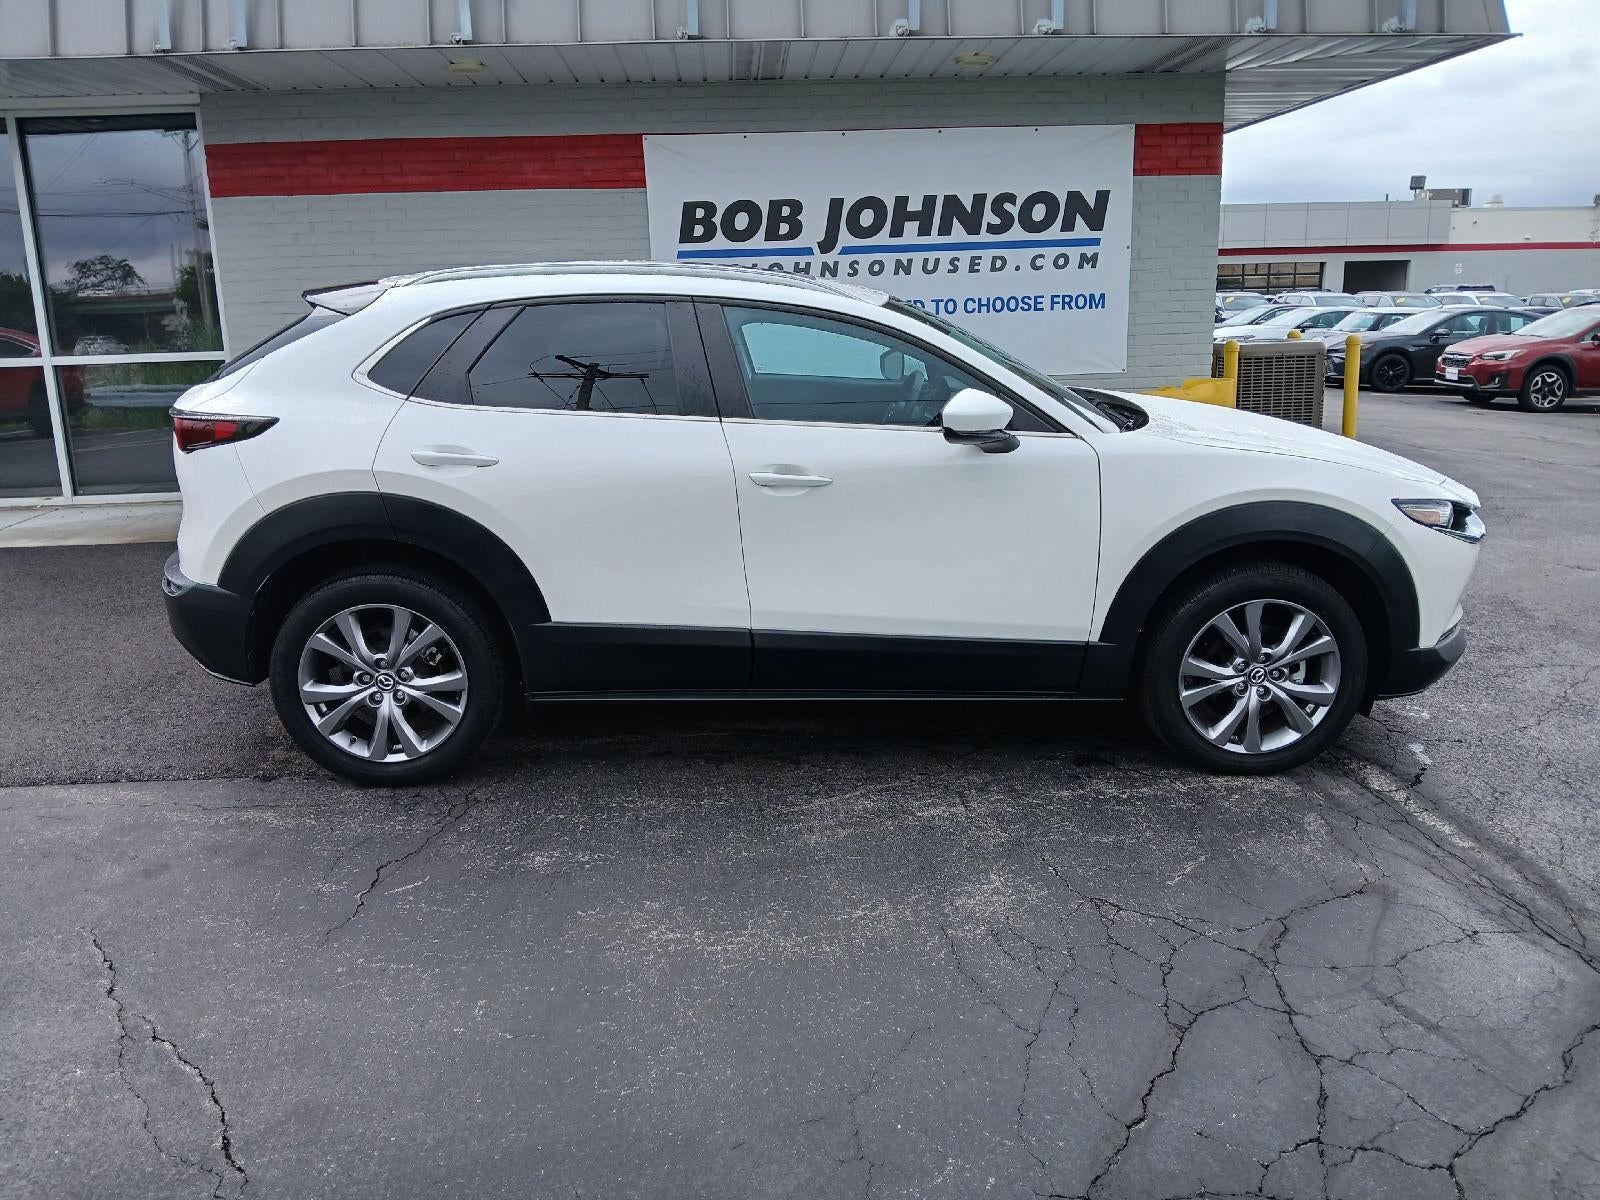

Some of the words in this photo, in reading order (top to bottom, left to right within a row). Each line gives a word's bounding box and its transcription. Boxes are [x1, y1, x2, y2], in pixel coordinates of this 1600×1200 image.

[679, 199, 803, 244] BOB
[817, 190, 1110, 254] JOHNSON
[732, 252, 1100, 278] HNSONUSED.COM
[931, 298, 957, 315] TO
[963, 295, 1045, 315] CHOOSE
[1050, 293, 1106, 311] FROM
